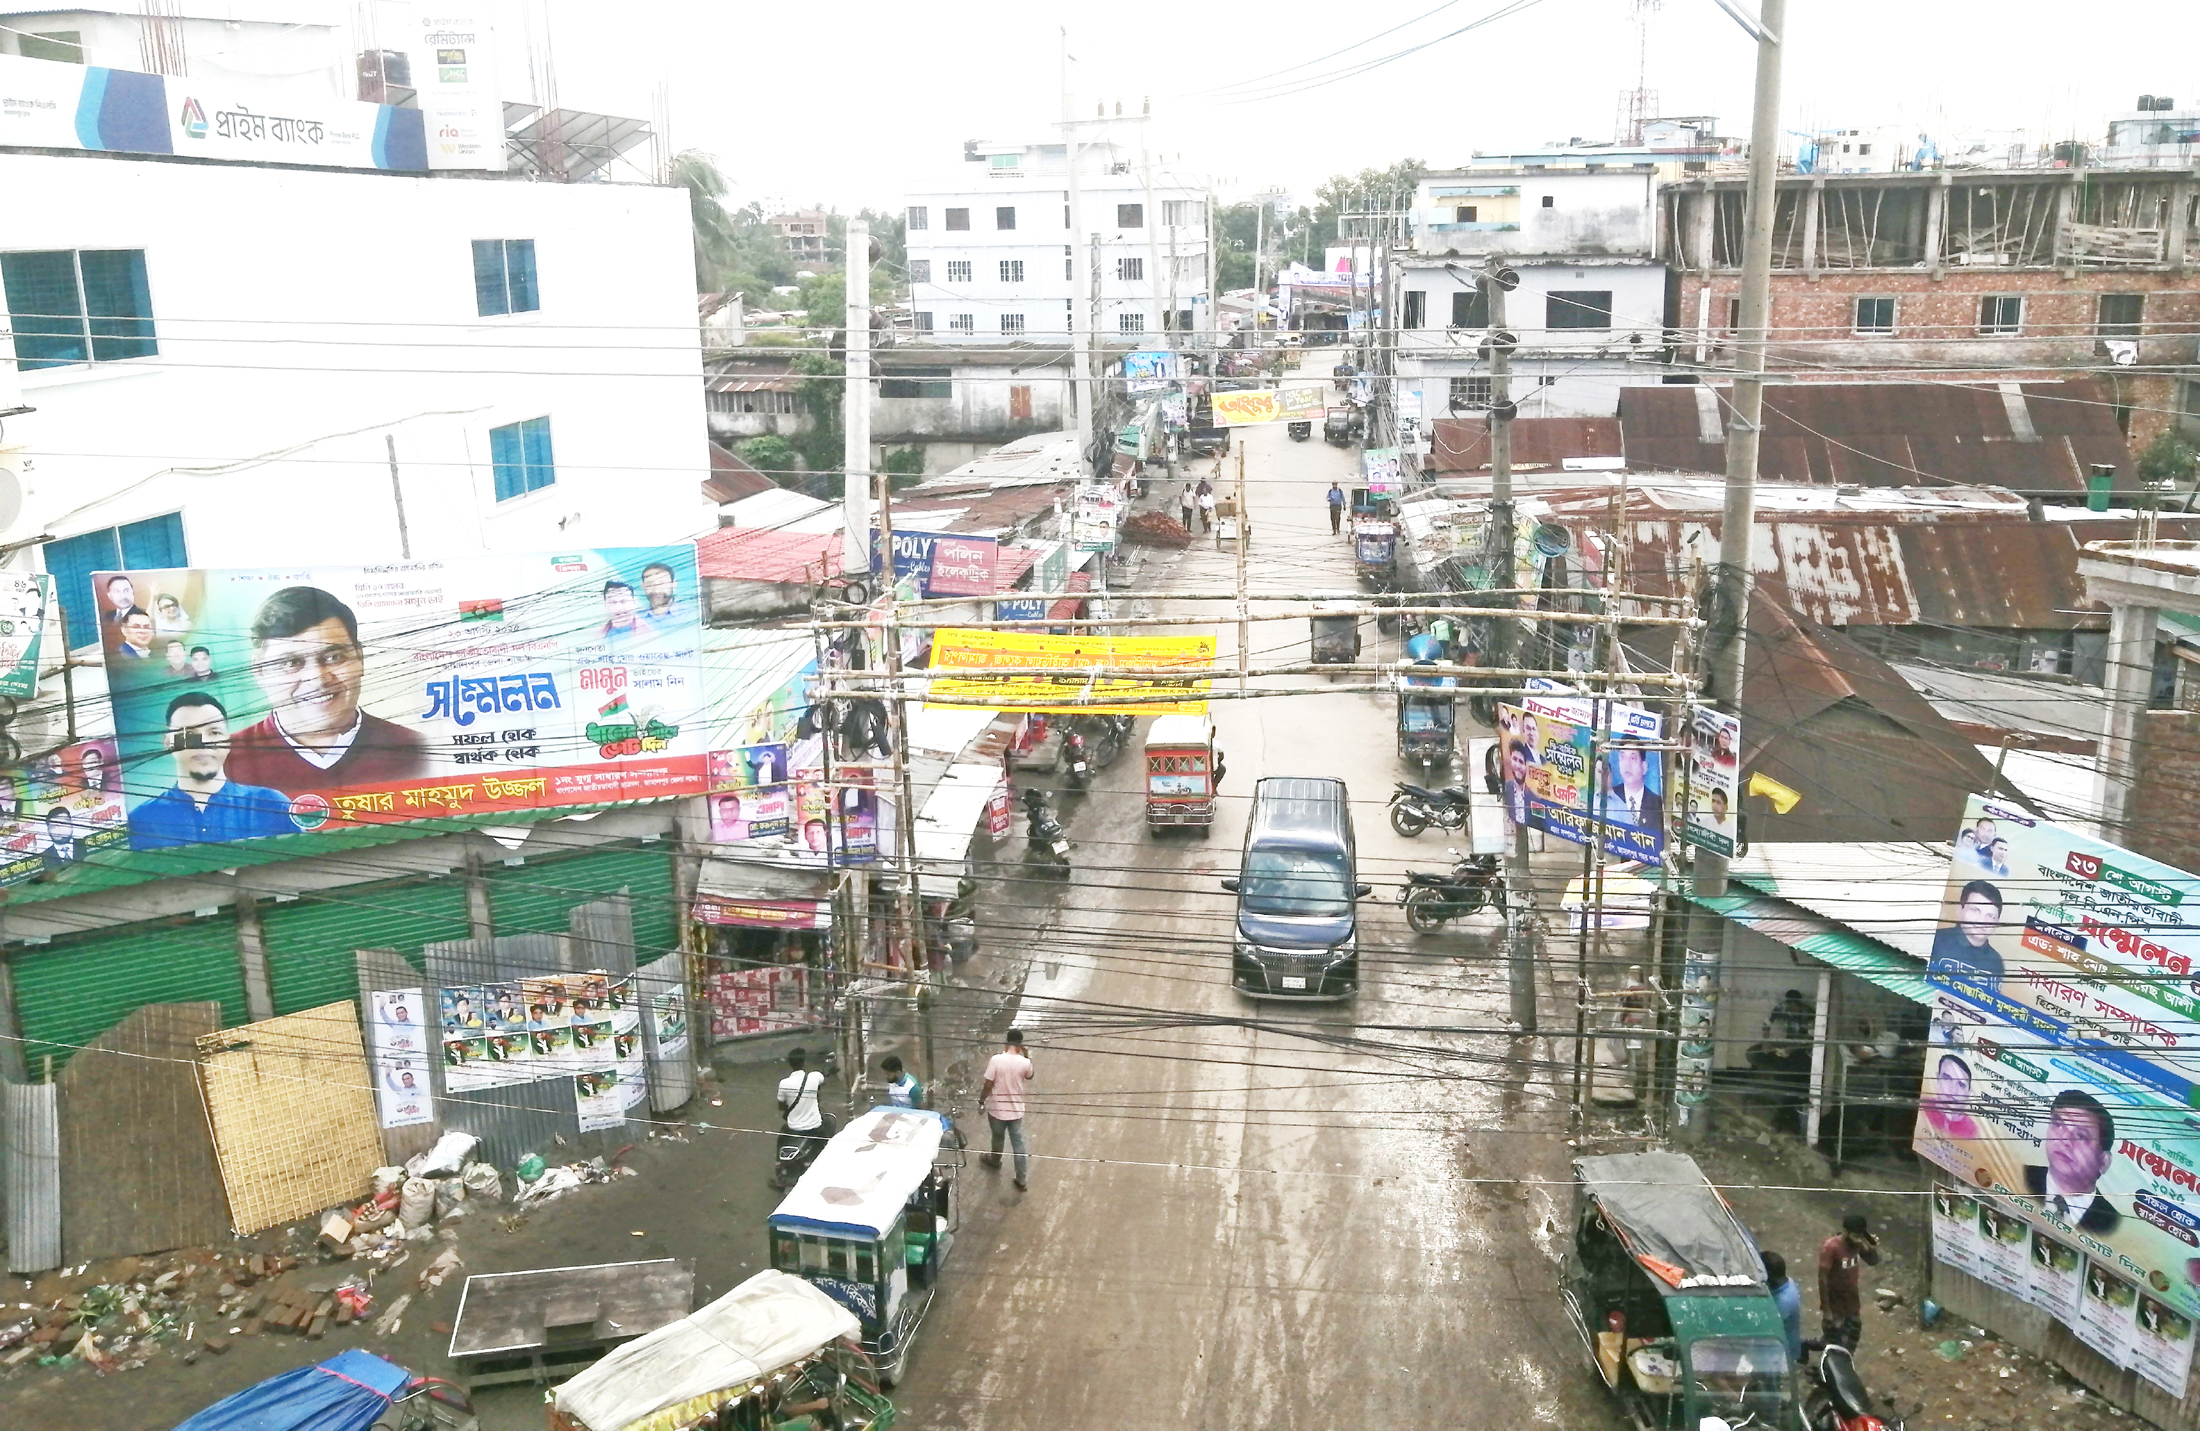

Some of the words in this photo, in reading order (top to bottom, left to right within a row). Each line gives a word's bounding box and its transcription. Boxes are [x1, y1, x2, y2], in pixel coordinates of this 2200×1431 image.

[424, 30, 476, 46] রেমিট্যান্স
[215, 103, 266, 141] প্রাইম
[269, 116, 324, 145] ব্যাংক
[439, 124, 459, 138] ria
[892, 536, 931, 559] POLY
[943, 545, 985, 564] পলিন
[1012, 600, 1042, 611] POLY
[579, 666, 628, 695] মামুন
[632, 678, 663, 690] সালাম
[666, 674, 685, 688] নিন
[421, 672, 562, 727] সম্মেলন
[452, 732, 495, 746] সফল
[501, 728, 537, 744] হোক
[641, 736, 669, 754] দিন
[504, 745, 541, 762] হোক
[1545, 748, 1583, 771] সম্মেলন
[594, 771, 627, 782] সাধারণ
[332, 791, 395, 822] তুষার
[402, 782, 476, 812] মাহমুদ
[1630, 830, 1656, 852] খান
[2070, 855, 2098, 875] ২৩
[2105, 869, 2124, 885] শে
[2128, 875, 2173, 901] আগস্ট
[2037, 864, 2097, 894] বাংলাদেশ
[2100, 887, 2185, 927] জাতীয়তাবাদী
[2060, 889, 2080, 902] দল
[2033, 920, 2075, 944] জননেতা
[2077, 914, 2193, 976] সম্মেলন
[2019, 965, 2089, 1009] সাধারণ
[2093, 997, 2181, 1048] সম্পাদক
[2035, 995, 2071, 1018] হিসেবে
[2163, 990, 2196, 1014] আলী
[2014, 1057, 2043, 1079] আগস্ট
[2118, 1140, 2200, 1196] সম্মেল
[2151, 1179, 2186, 1206] ২০২৫
[2144, 1194, 2168, 1214] সফল
[2170, 1209, 2197, 1228] হোক
[2039, 1209, 2073, 1235] শীষে
[2078, 1234, 2114, 1258] ভোট
[2118, 1254, 2148, 1279] দিন
[2167, 1224, 2193, 1243] হোক
